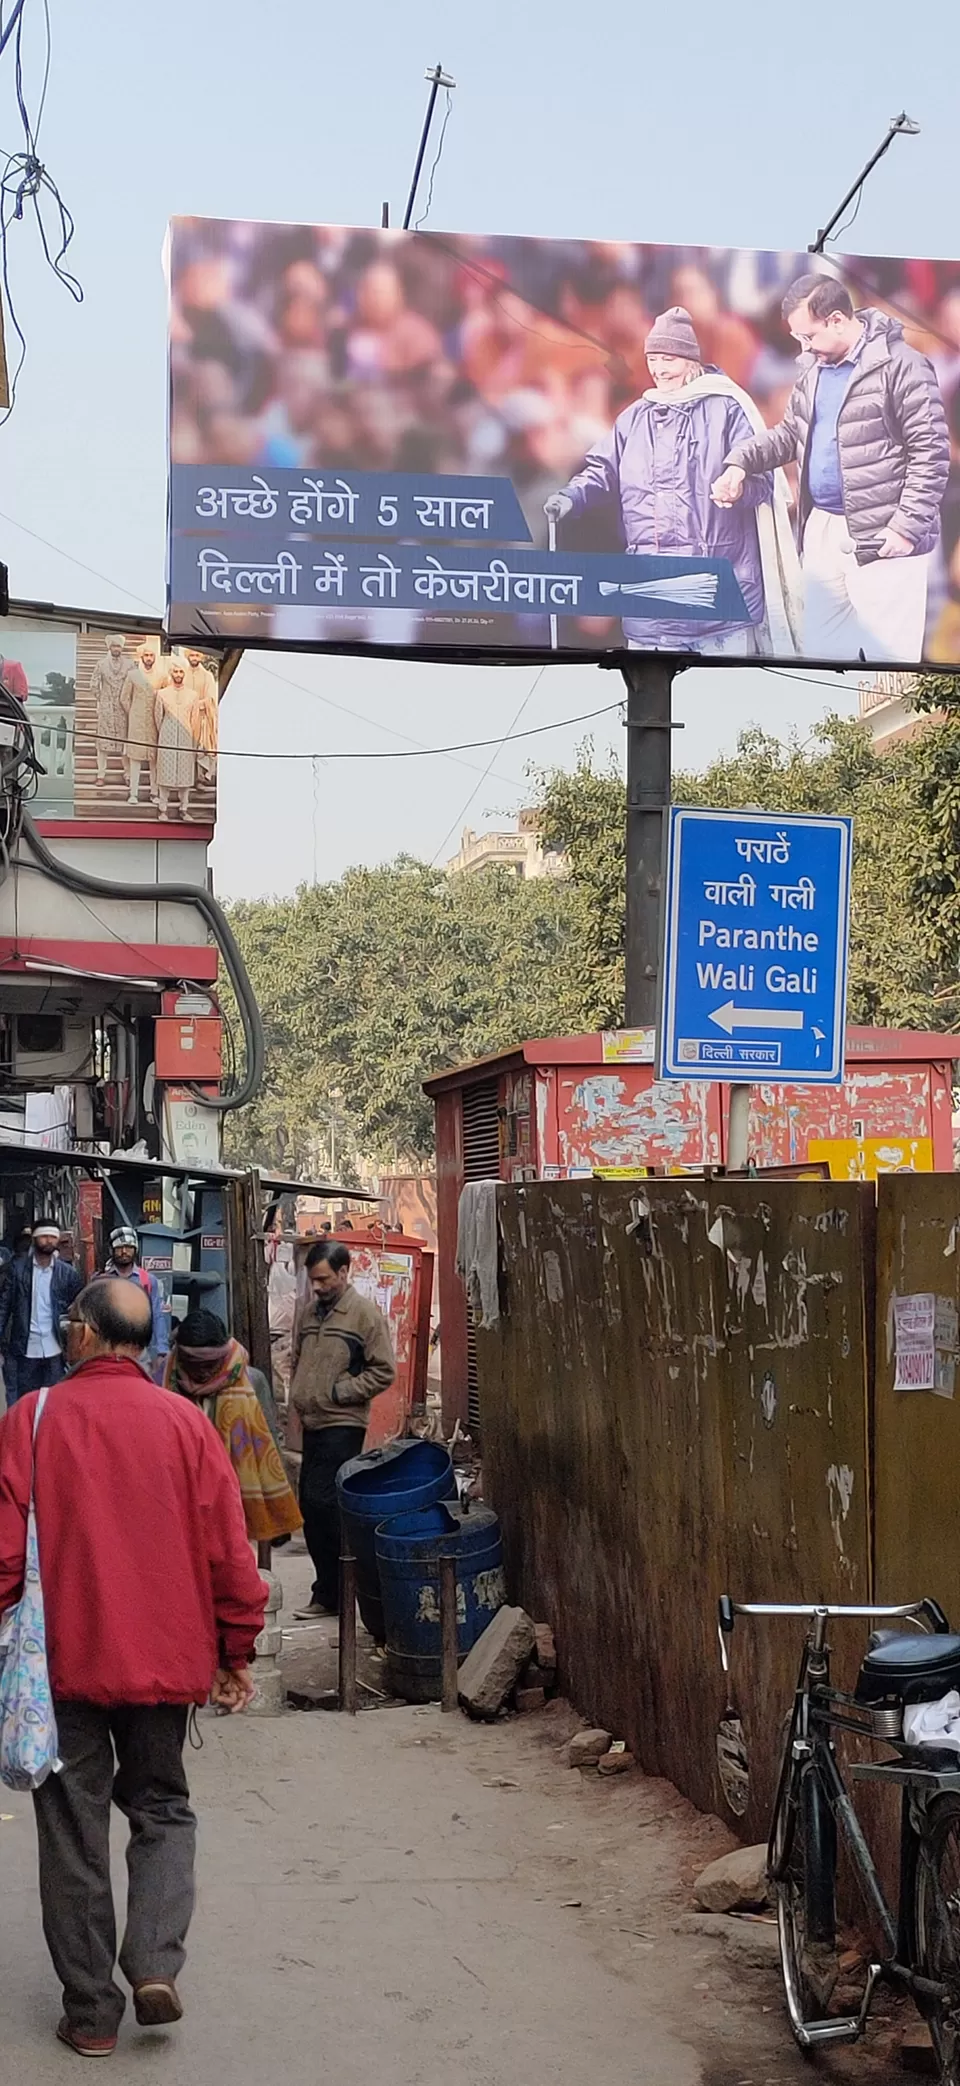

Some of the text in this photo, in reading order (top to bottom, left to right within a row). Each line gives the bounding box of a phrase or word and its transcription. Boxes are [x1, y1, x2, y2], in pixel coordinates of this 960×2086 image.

[196, 476, 495, 529] अच्छे होंगे 5 साल
[197, 549, 583, 605] दिल्ली में तो केजरीवाल
[734, 832, 791, 864] पराठें
[703, 873, 816, 910] वाली गली
[698, 920, 819, 952] Paranthe
[696, 962, 817, 994] Wali Gali
[702, 1044, 777, 1062] दिल्ली सरकार
